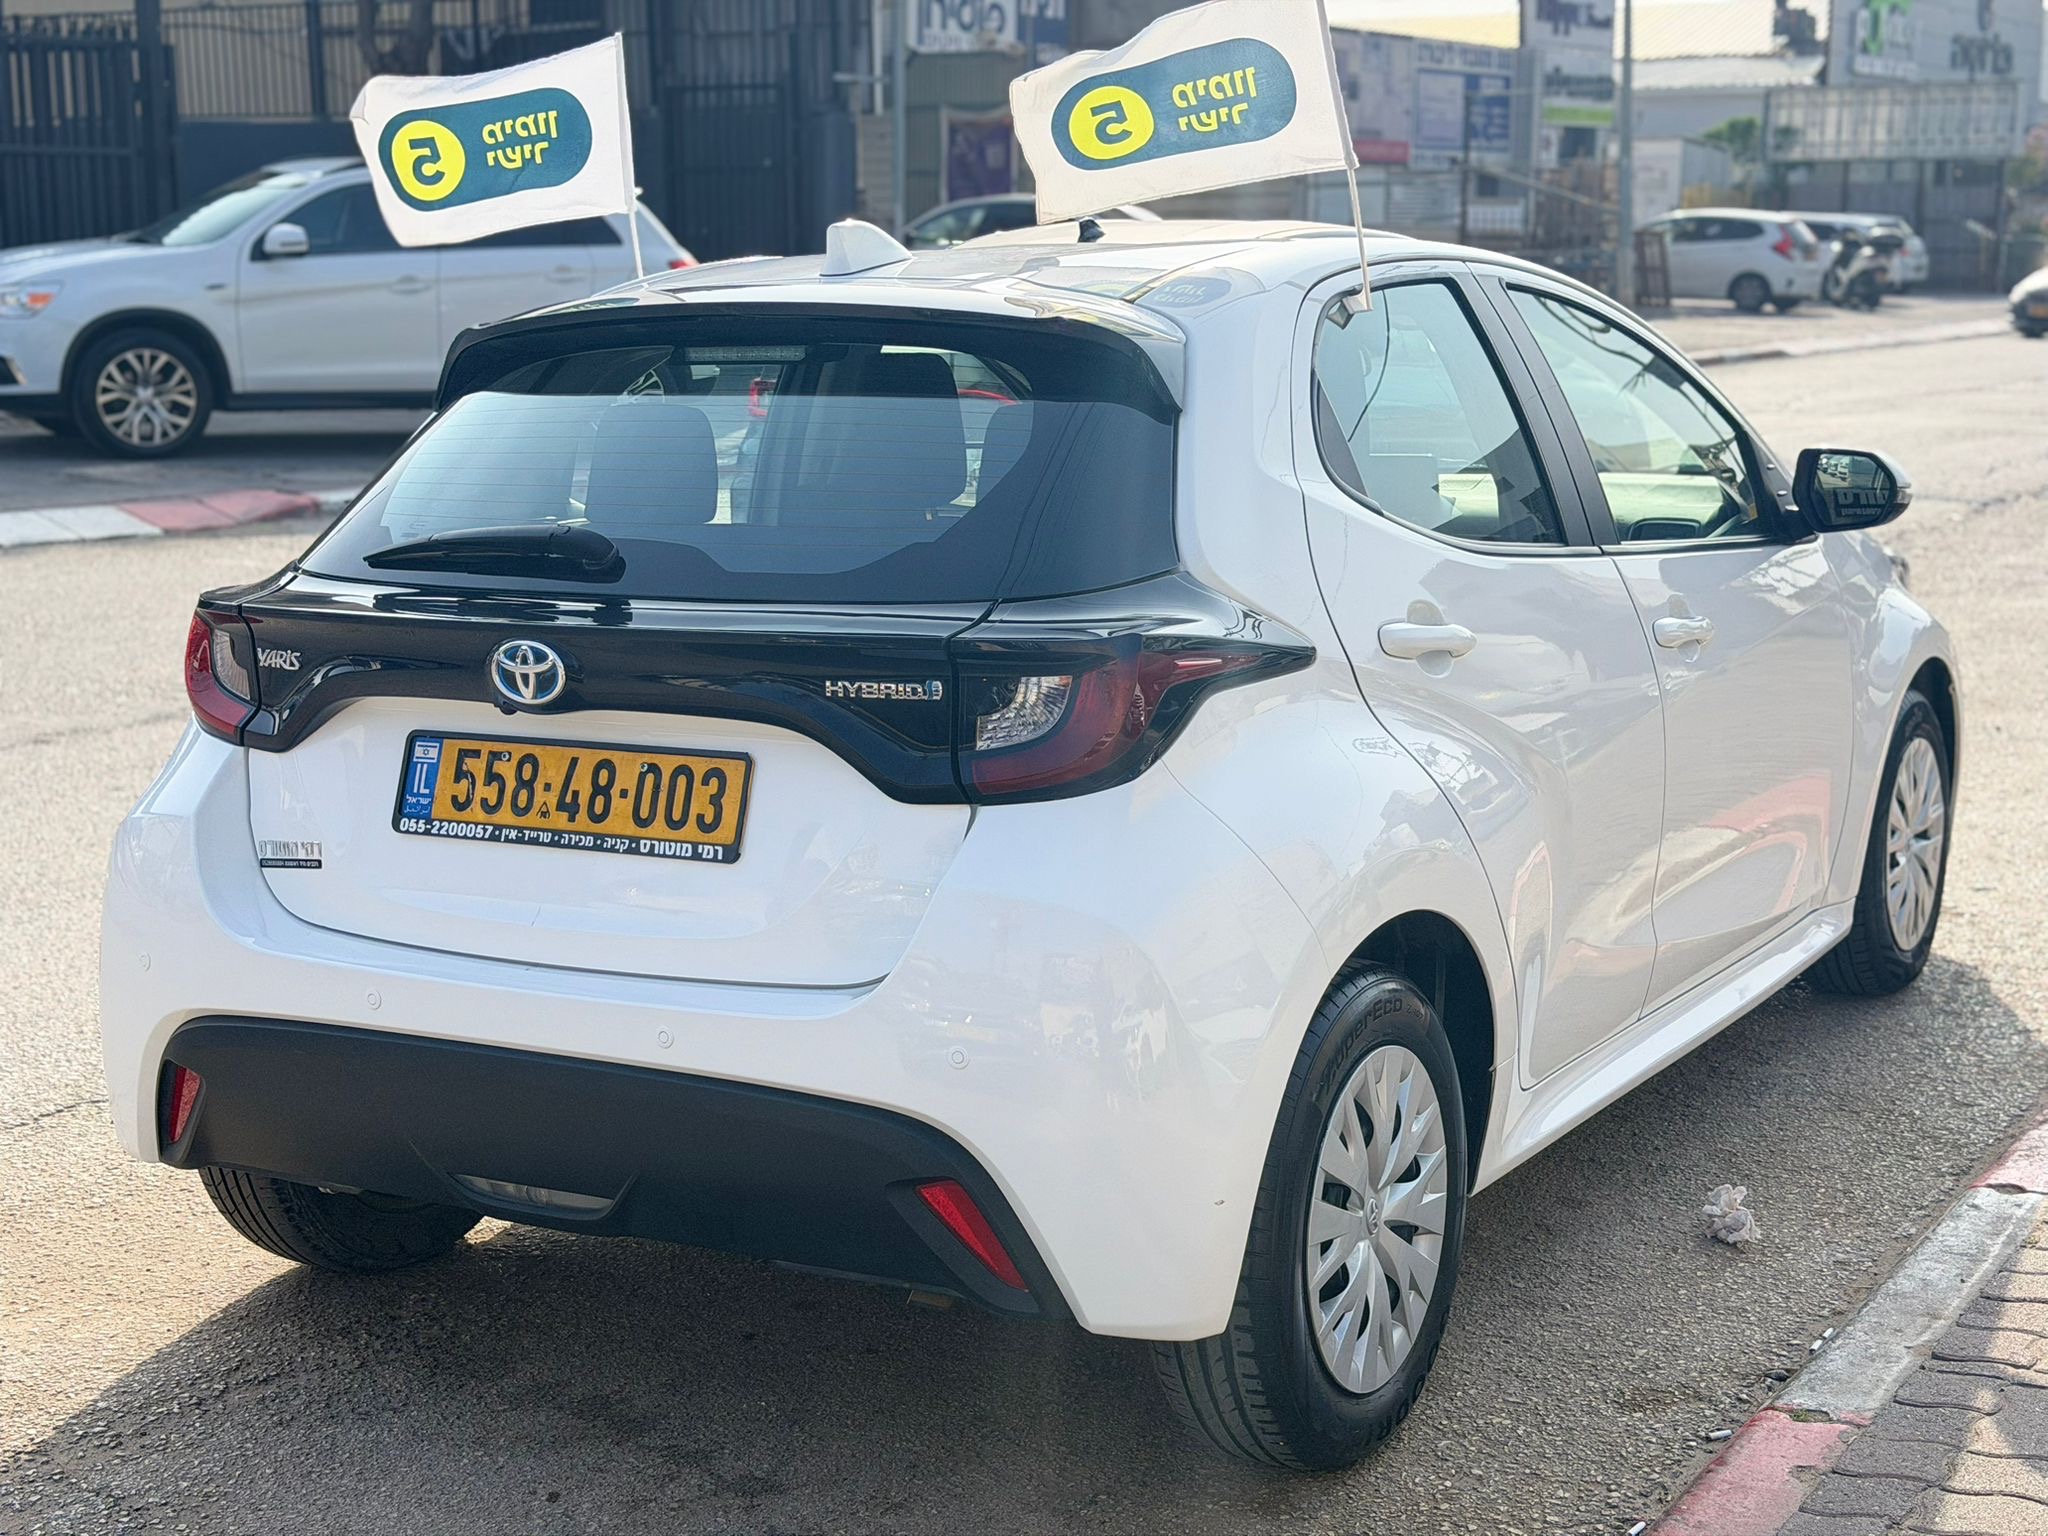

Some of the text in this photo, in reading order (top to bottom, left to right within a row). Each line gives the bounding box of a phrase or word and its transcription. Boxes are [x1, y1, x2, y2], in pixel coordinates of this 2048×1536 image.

[825, 680, 923, 700] HYBRID
[413, 763, 431, 794] IL
[406, 794, 432, 805] ישראל
[399, 817, 724, 860] רמי מוטורס קניה מכירה טרייד-אין 055-2200057
